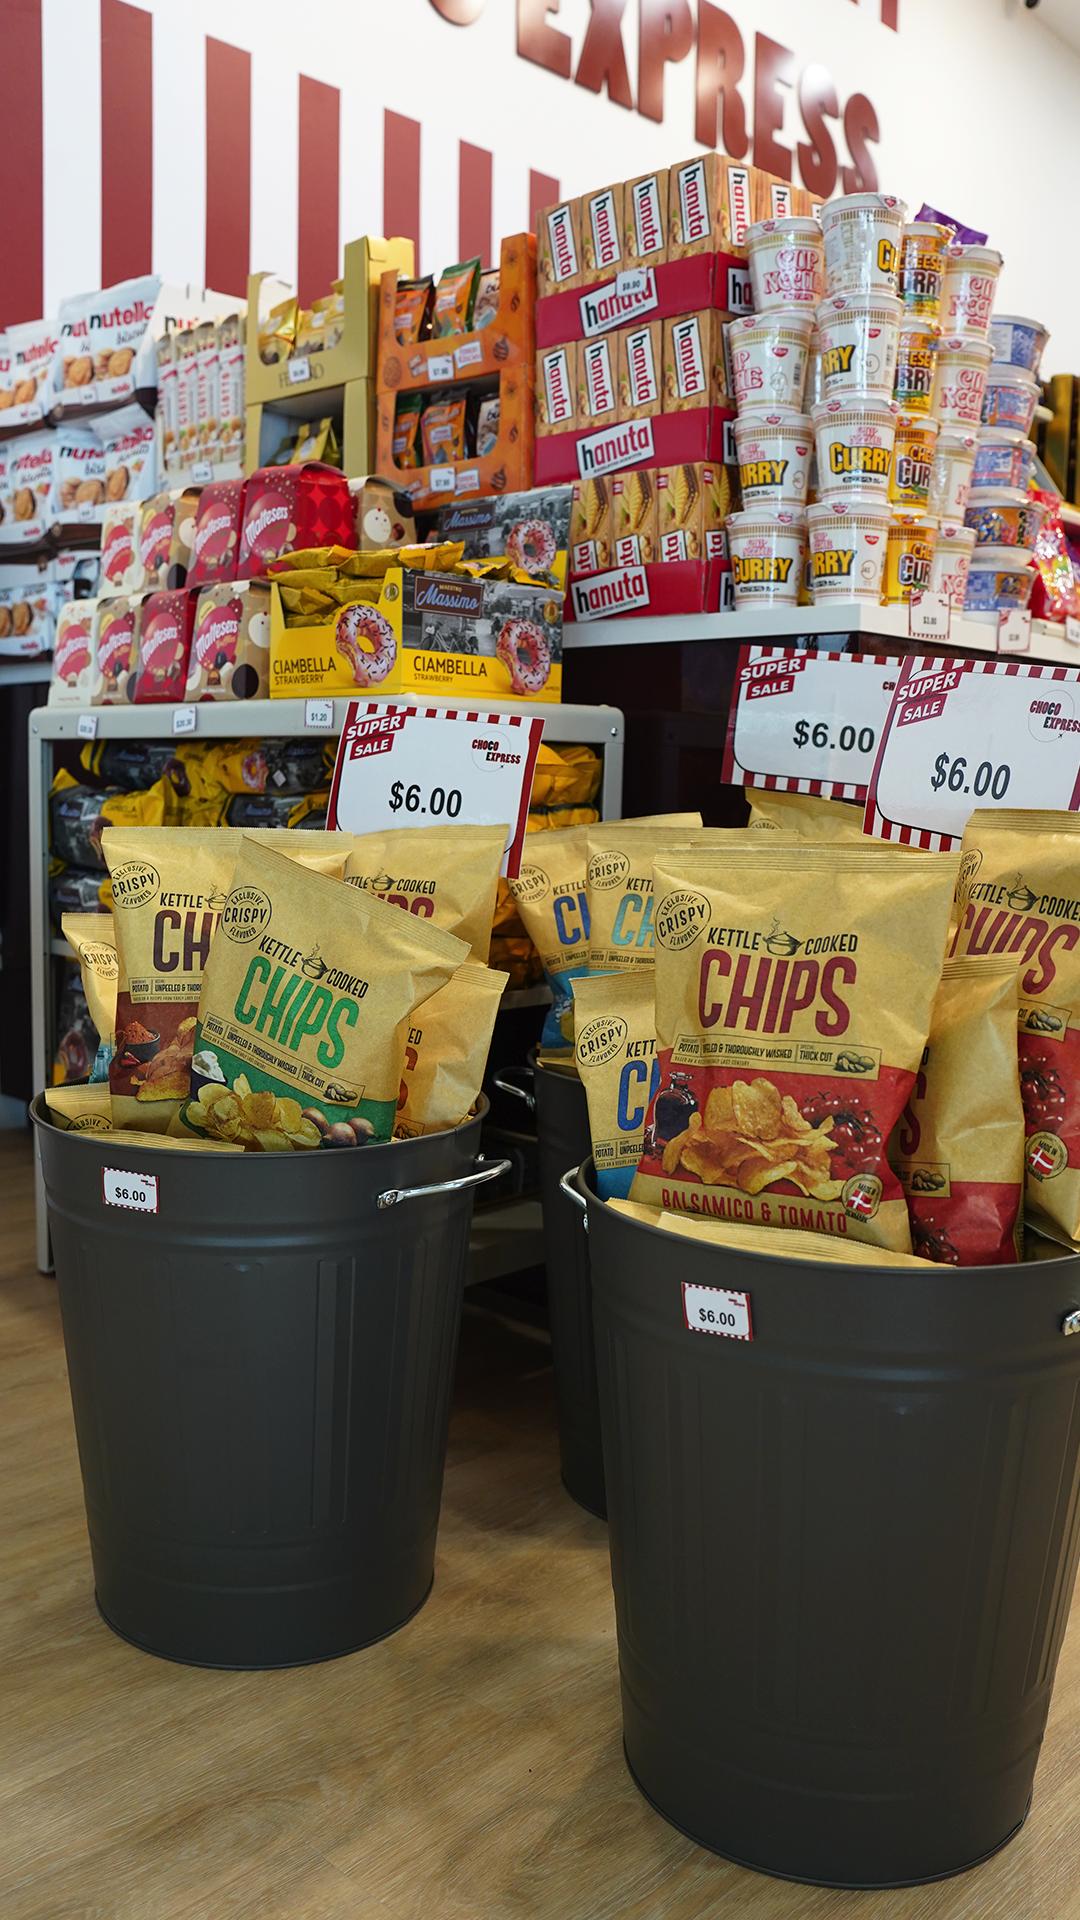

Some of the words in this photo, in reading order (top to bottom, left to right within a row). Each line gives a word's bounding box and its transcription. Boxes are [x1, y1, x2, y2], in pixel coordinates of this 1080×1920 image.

[516, 0, 879, 198] EXPRESS
[684, 167, 704, 239] hanuta
[733, 172, 747, 243] hanuta
[638, 182, 657, 251] hanuta
[595, 195, 615, 264] hanuta
[552, 210, 573, 276] hanuta
[632, 333, 652, 401] hanuta
[679, 322, 699, 391] hanuta
[548, 354, 568, 418] hanuta
[589, 345, 609, 411] hanuta
[581, 425, 650, 471] hanuta
[829, 442, 891, 476] CURRY
[245, 506, 289, 548] Maltesers
[444, 511, 492, 531] Massimo
[732, 555, 793, 585] CURRY
[416, 583, 479, 609] Massimo
[575, 572, 645, 613] hanuta
[196, 620, 238, 663] Maltesers
[273, 655, 337, 675] CIAMBELLA
[413, 655, 488, 677] CIAMBELLA
[740, 657, 801, 681] SUPER
[274, 673, 325, 685] STRAWBERRY
[413, 673, 454, 684] STRAWBERRY
[751, 680, 789, 697] SALE
[897, 671, 957, 702] SUPER
[311, 712, 328, 722] $1.20
[903, 700, 942, 723] SALE
[1029, 700, 1061, 716] CHOCO
[346, 714, 401, 740] SUPER
[793, 719, 875, 753] $6.00
[354, 738, 388, 757] SALE
[471, 739, 499, 751] CHOCO
[486, 751, 521, 765] EXPRESS
[931, 752, 1011, 800] $6.00
[388, 780, 462, 817] $6.00
[113, 866, 147, 880] EXCLUSIVE
[589, 861, 626, 881] CRISPY
[112, 873, 155, 898] CRISPY
[396, 878, 436, 895] COOKED
[511, 873, 546, 897] CRISPY
[969, 882, 1007, 904] KETTLE
[122, 890, 152, 905] FLAVORED
[160, 892, 204, 908] KETTLE
[231, 891, 265, 906] EXCLUSIVE
[660, 893, 698, 916] EXCLUSIVE
[224, 907, 267, 924] CRISPY
[658, 902, 706, 938] CRISPY
[153, 909, 221, 972] CH
[229, 926, 257, 939] FLAVORED
[669, 923, 699, 945] FLAVORED
[706, 927, 761, 950] KETTLE
[804, 933, 858, 955] COOKED
[258, 935, 302, 966] KETTLE
[326, 968, 370, 999] COOKED
[155, 984, 180, 992] UNPEELED
[698, 949, 857, 1037] CHIPS
[234, 956, 360, 1069] CHIPS
[579, 1023, 623, 1058] CRISPY
[583, 1019, 616, 1040] EXCLUSIVE
[588, 1043, 618, 1063] FLAVORED
[625, 1039, 656, 1058] KETT
[678, 1042, 699, 1053] POTATO
[724, 1044, 765, 1058] THOROUGHLY
[765, 1048, 793, 1059] WASHED
[799, 1050, 818, 1061] THICK
[819, 1051, 833, 1063] CUT
[115, 1187, 146, 1202] $6.00
[662, 1188, 753, 1219] BALSAMICO
[760, 1203, 771, 1221] &
[778, 1205, 848, 1233] TOMATO
[699, 1308, 735, 1327] $6.00
